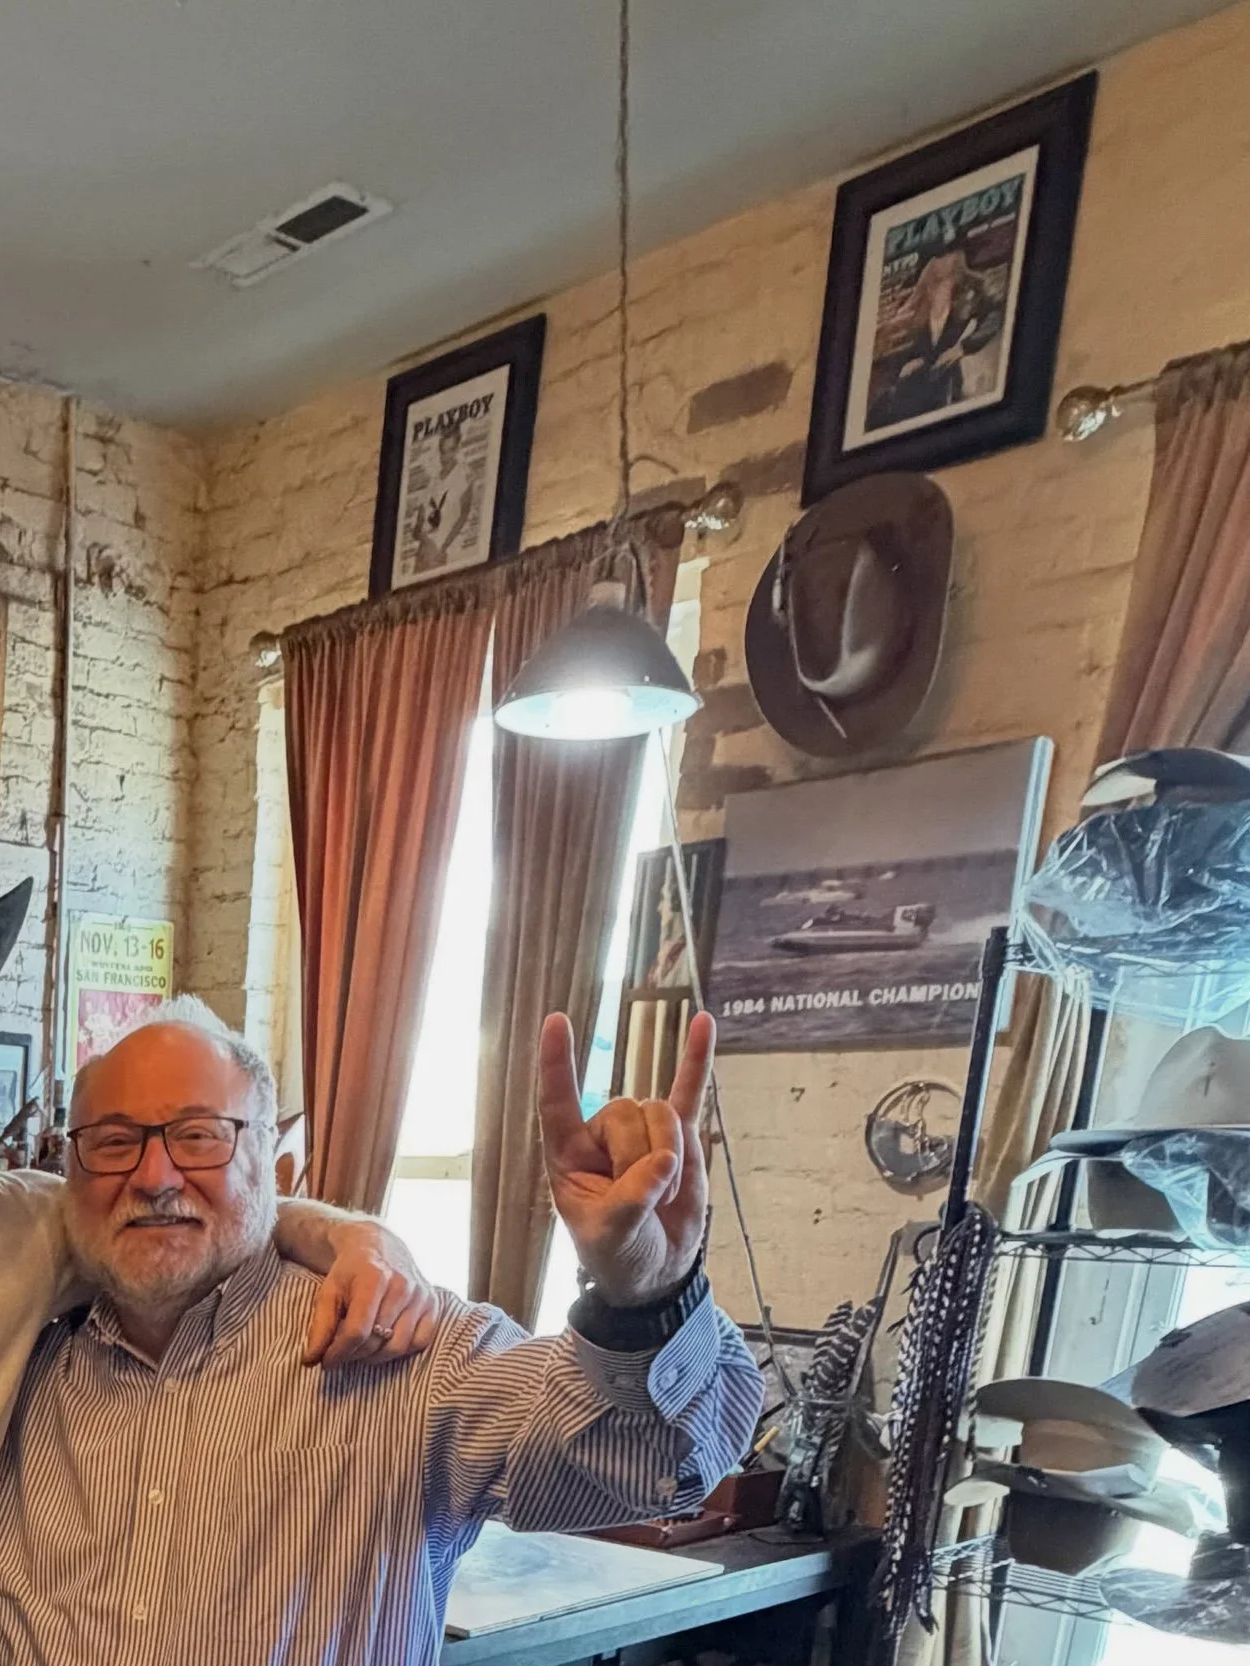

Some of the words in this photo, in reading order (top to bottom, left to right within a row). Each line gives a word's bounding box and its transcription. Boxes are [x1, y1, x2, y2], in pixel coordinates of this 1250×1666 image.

[884, 173, 1025, 260] PLAYBOY
[412, 392, 495, 444] PLAYBOY
[80, 930, 118, 957] NOV.
[124, 935, 165, 960] 13-16
[76, 970, 99, 984] SAN
[104, 971, 166, 989] FRANCISCO
[722, 998, 765, 1017] 1984
[770, 990, 863, 1013] NATIONAL
